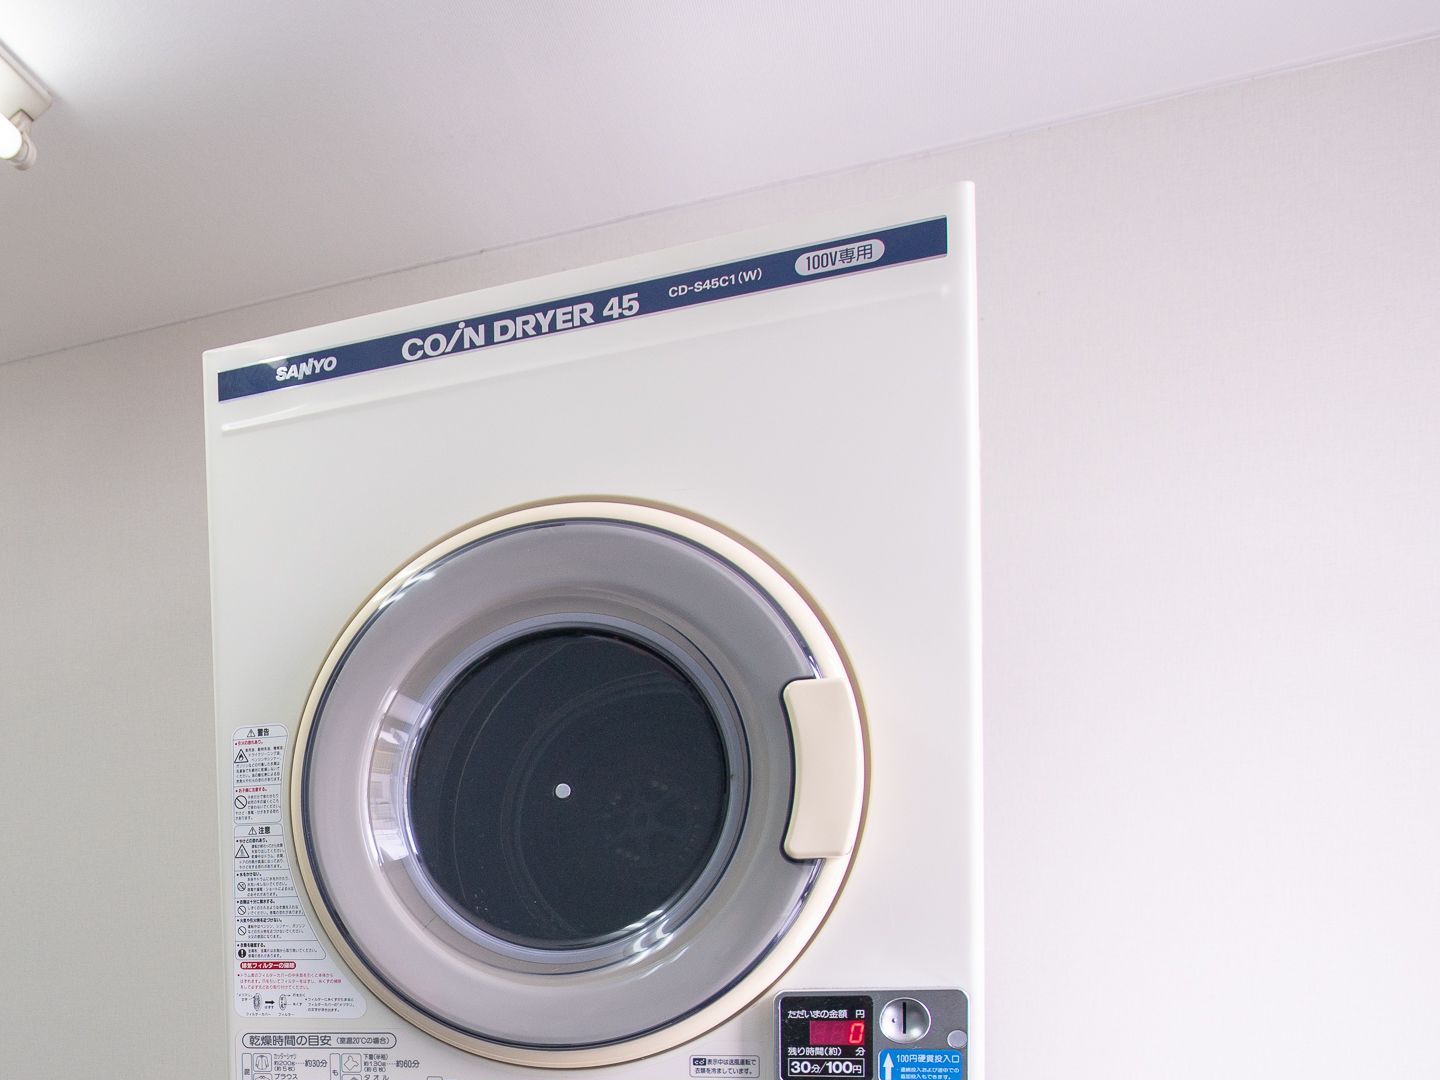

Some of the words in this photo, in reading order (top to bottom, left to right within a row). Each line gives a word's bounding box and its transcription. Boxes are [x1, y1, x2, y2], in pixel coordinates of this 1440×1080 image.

[805, 244, 873, 272] 100V専用
[275, 356, 337, 381] SANYO
[494, 301, 595, 343] DRYER
[602, 292, 640, 319] 45
[668, 267, 763, 298] CD-S45C1(W)
[788, 1010, 848, 1019] ただいまの金額
[856, 1010, 865, 1018] 円
[849, 1023, 864, 1044] 0
[249, 1035, 332, 1046] 乾燥時間の目安
[855, 1047, 865, 1056] 分
[896, 1054, 960, 1064] 100円硬貨投入口
[790, 1061, 862, 1074] 30分/100円
